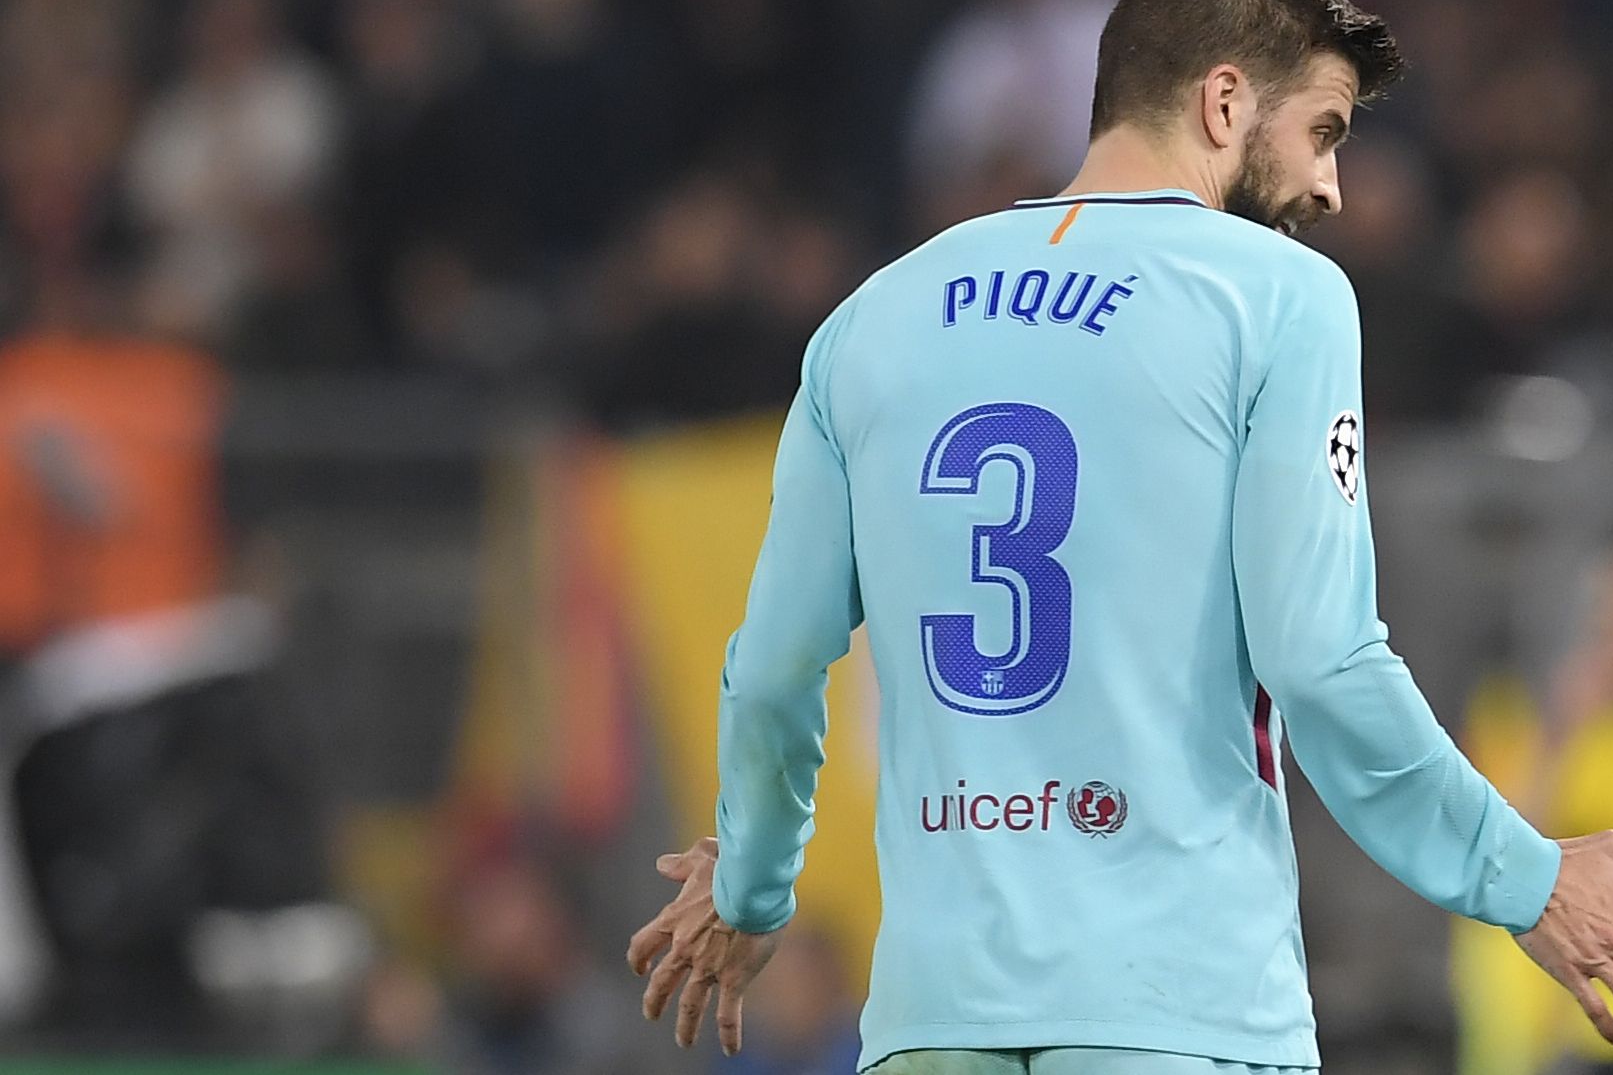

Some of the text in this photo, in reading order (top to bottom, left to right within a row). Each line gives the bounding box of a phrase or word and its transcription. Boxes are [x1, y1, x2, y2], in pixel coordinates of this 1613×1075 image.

[943, 270, 1138, 336] PIQUÉ
[919, 401, 1078, 717] 3
[921, 779, 1061, 832] uicef
